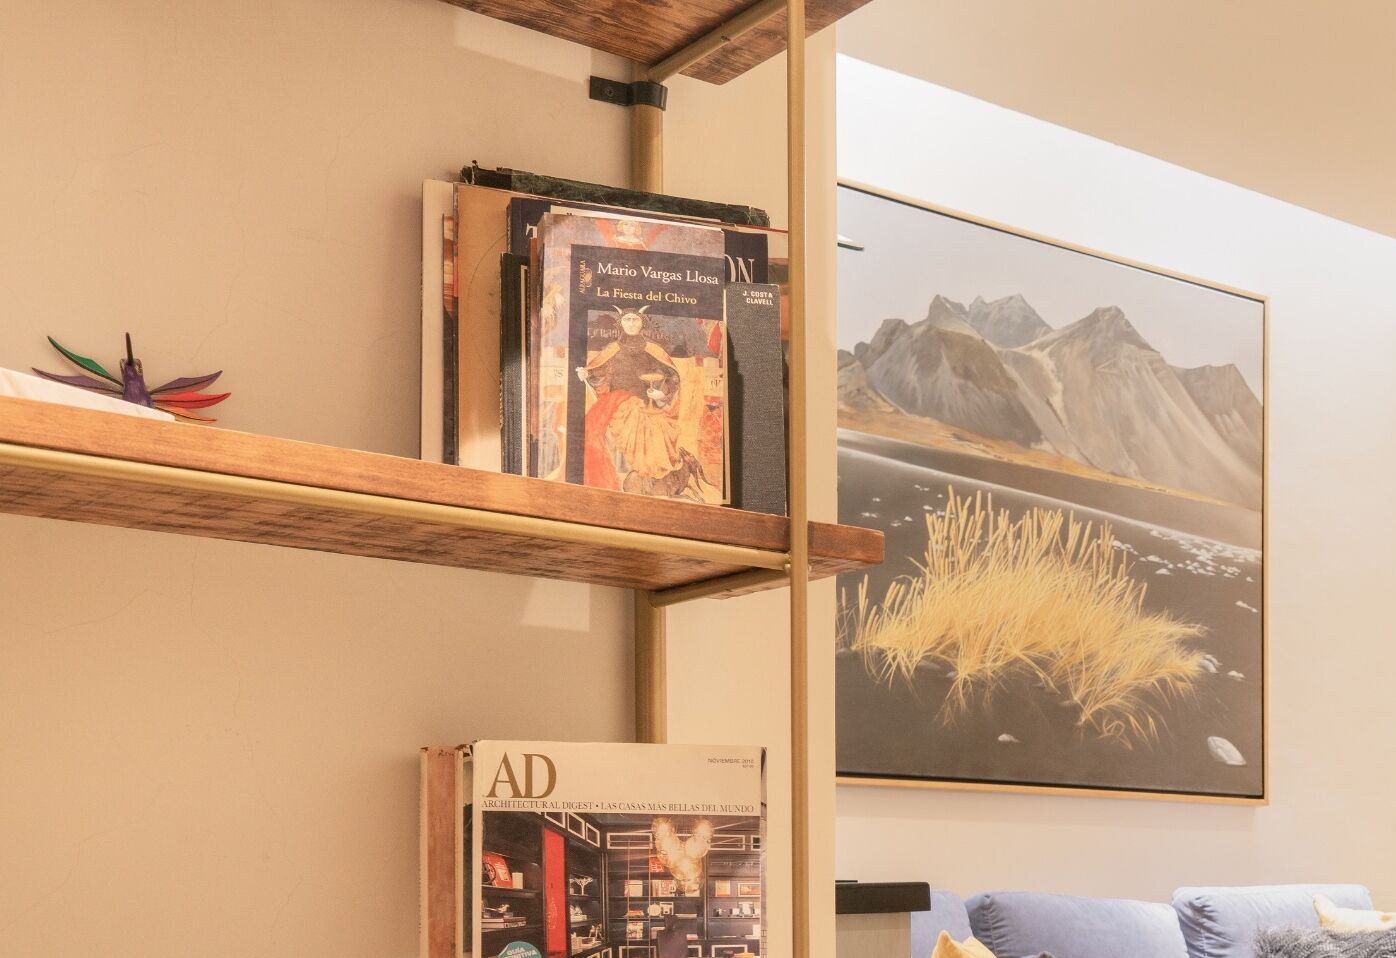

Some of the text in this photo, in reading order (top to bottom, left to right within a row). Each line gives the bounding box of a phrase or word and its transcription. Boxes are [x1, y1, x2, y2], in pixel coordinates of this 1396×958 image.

[597, 262, 719, 285] Mario Vargas Llosa
[597, 287, 697, 305] La Fiesta del Chivo
[746, 297, 774, 306] CLAVELL
[750, 291, 774, 299] COSTA
[485, 751, 557, 799] AD
[481, 800, 560, 809] ARCHITECTURAL
[562, 800, 593, 810] DIGEST
[601, 801, 617, 811] LAS
[619, 801, 646, 811] CASAS
[668, 802, 700, 812] BELLAS
[702, 803, 718, 813] DEL
[720, 803, 755, 813] MUNDO
